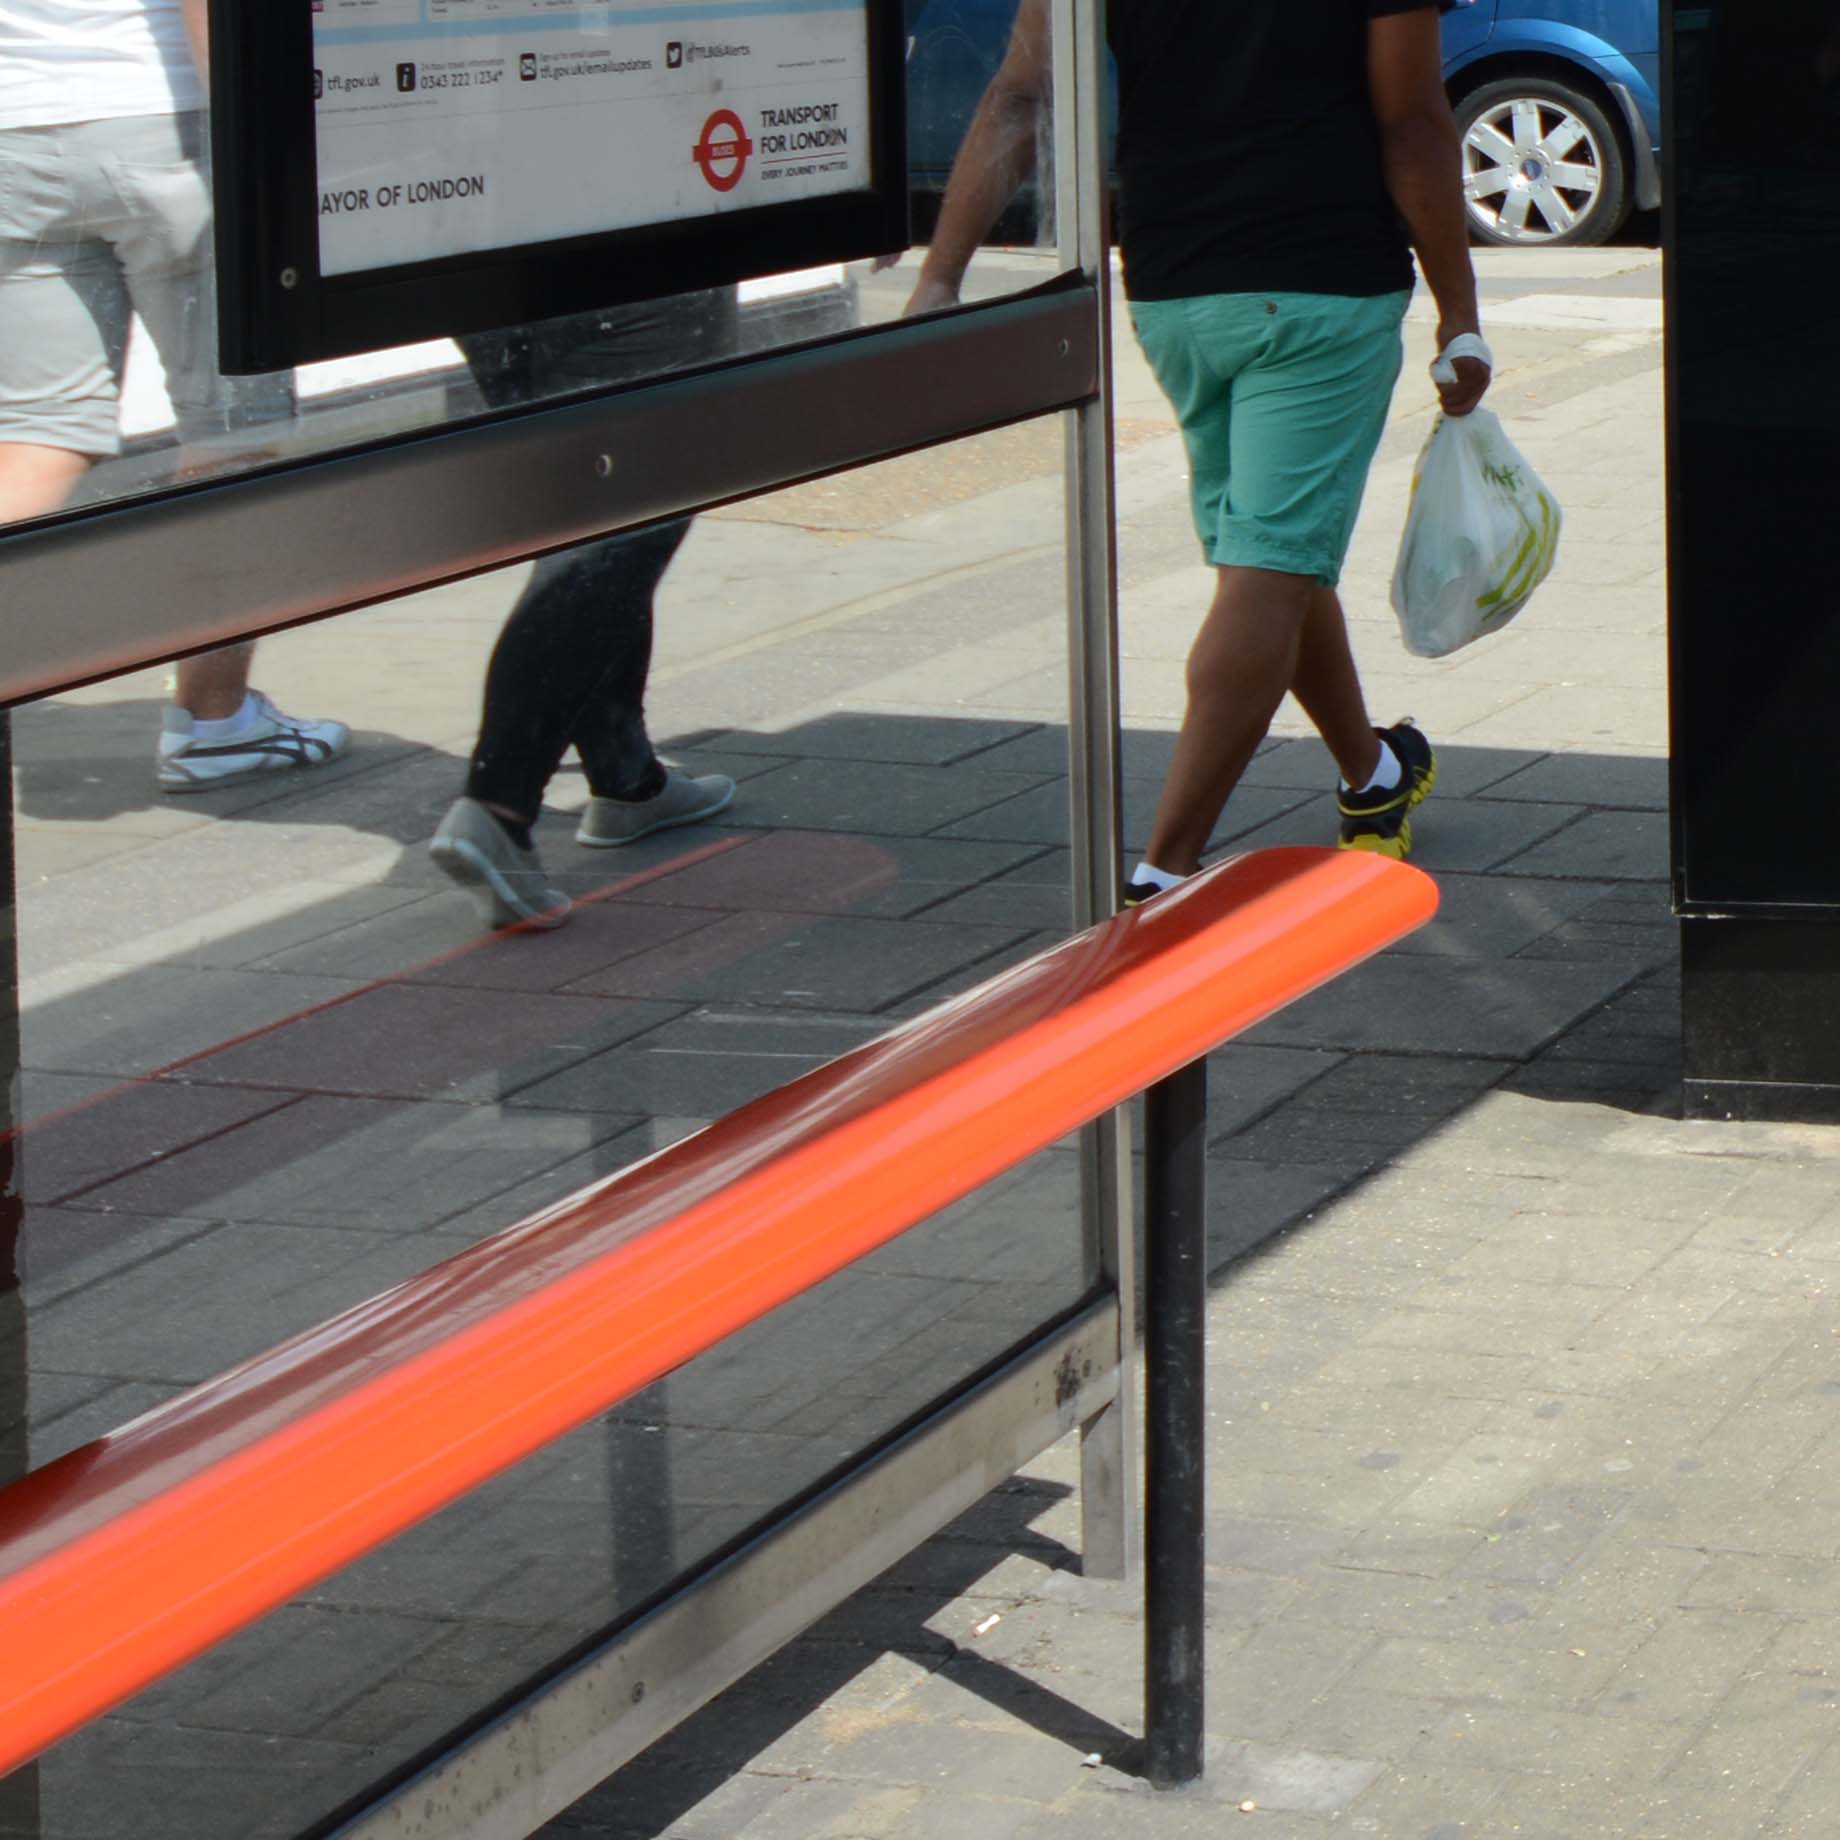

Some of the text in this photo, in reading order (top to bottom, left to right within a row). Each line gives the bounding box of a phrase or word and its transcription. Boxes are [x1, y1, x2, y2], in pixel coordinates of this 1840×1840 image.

[327, 73, 382, 92] tfl.gov.uk
[420, 76, 448, 90] 0343
[451, 73, 469, 87] 222
[761, 103, 839, 128] TRANSPORT
[761, 127, 848, 155] FOR LONDON
[320, 175, 485, 215] AYOR OF LONDON
